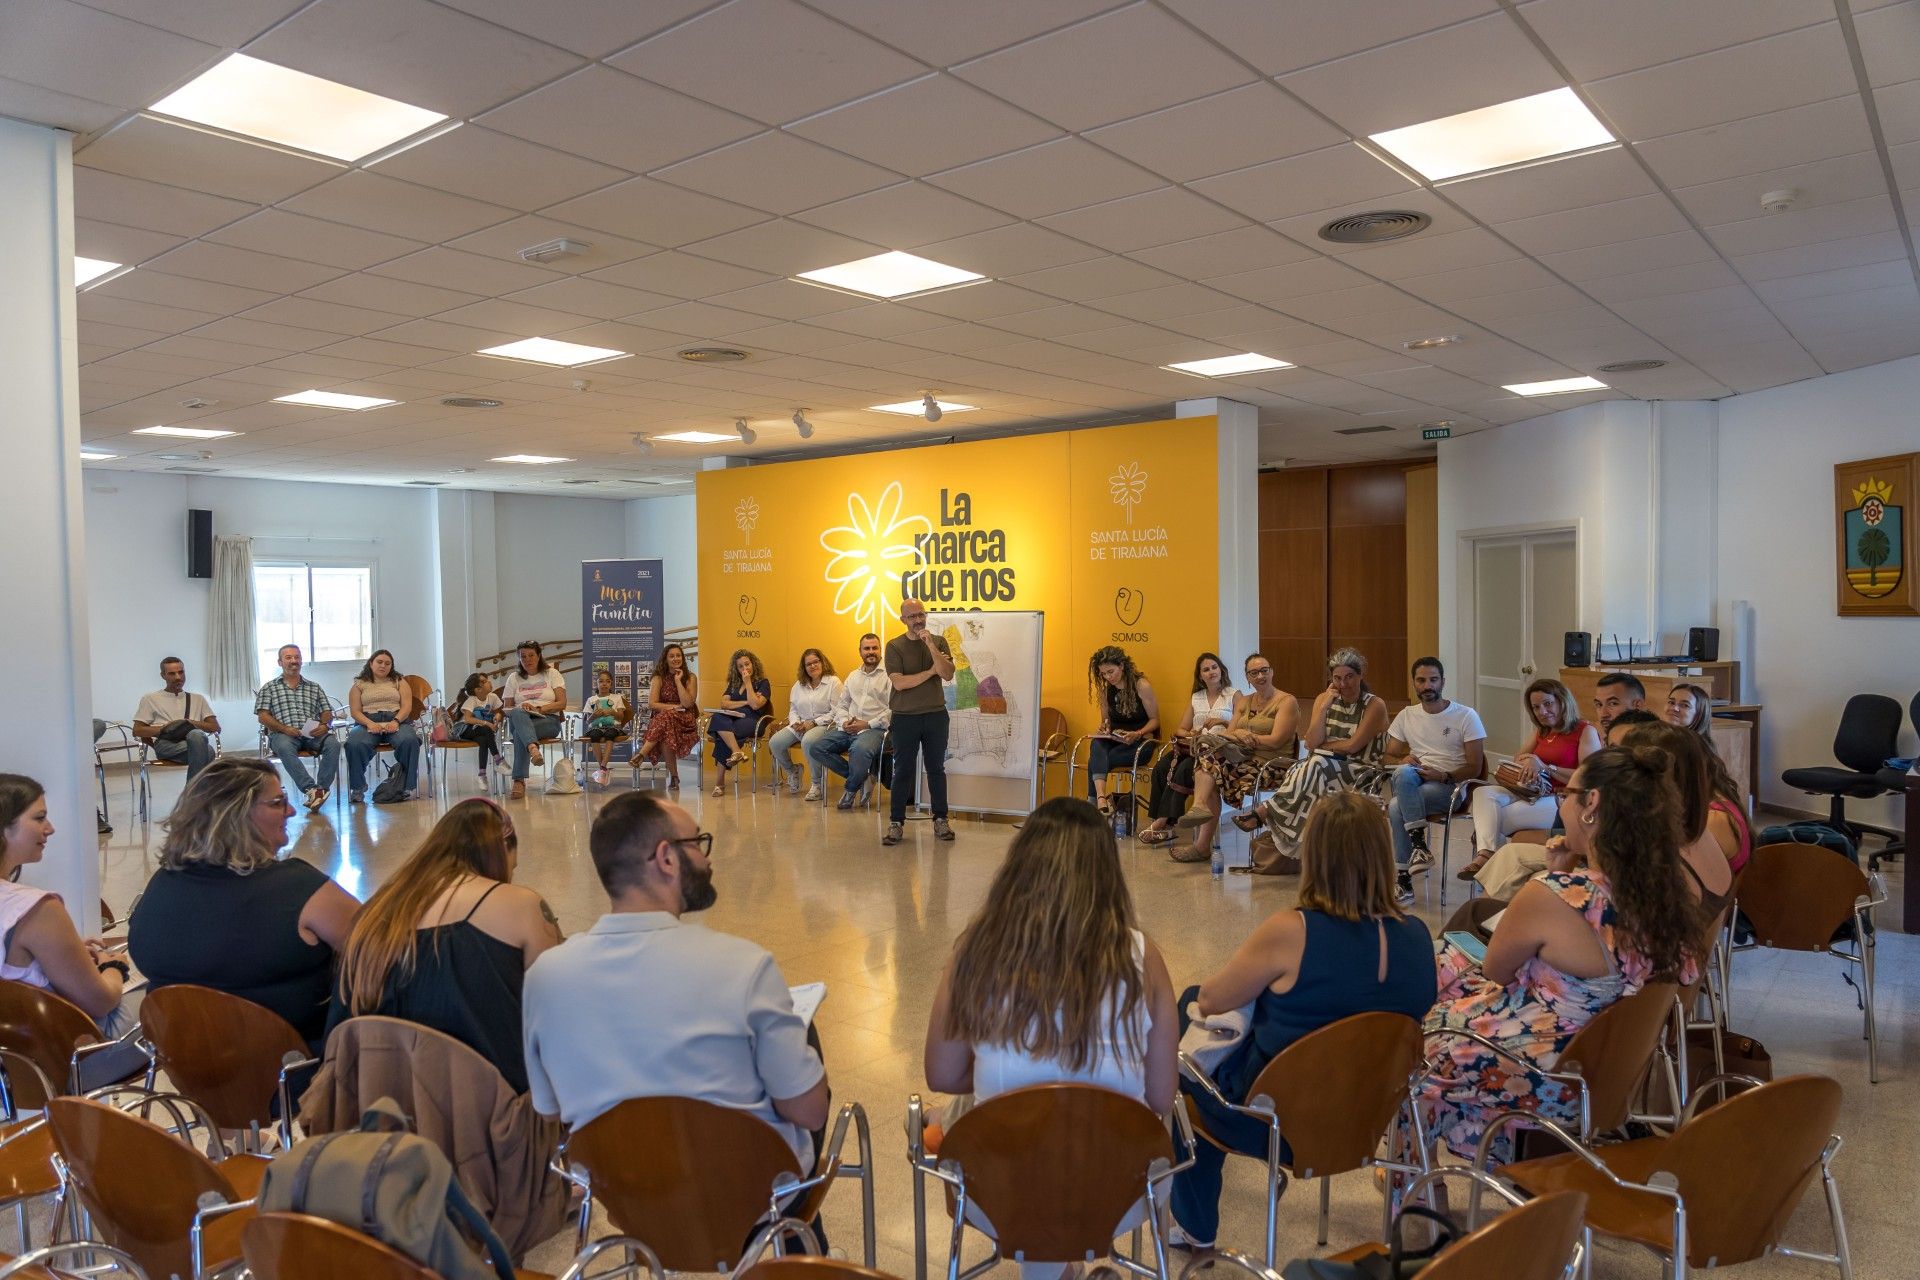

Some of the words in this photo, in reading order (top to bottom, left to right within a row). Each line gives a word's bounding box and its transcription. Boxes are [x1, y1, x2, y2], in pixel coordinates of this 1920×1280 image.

[1425, 430, 1448, 438] SALIDA
[940, 488, 972, 526] La
[1090, 530, 1129, 544] SANTA
[1132, 525, 1168, 542] LUCÍA
[723, 550, 748, 560] SANTA
[749, 547, 772, 559] LUCÍA
[914, 529, 1006, 565] marca
[1090, 547, 1107, 560] DE
[1111, 544, 1168, 559] TIRAJANA
[723, 563, 734, 573] DE
[736, 562, 772, 573] TIRAJANA
[901, 569, 954, 602] que
[960, 568, 1016, 602] nos
[600, 585, 643, 606] Mejor
[592, 603, 653, 623] Familia
[736, 630, 760, 639] SOMOS
[1111, 632, 1149, 643] SOMOS
